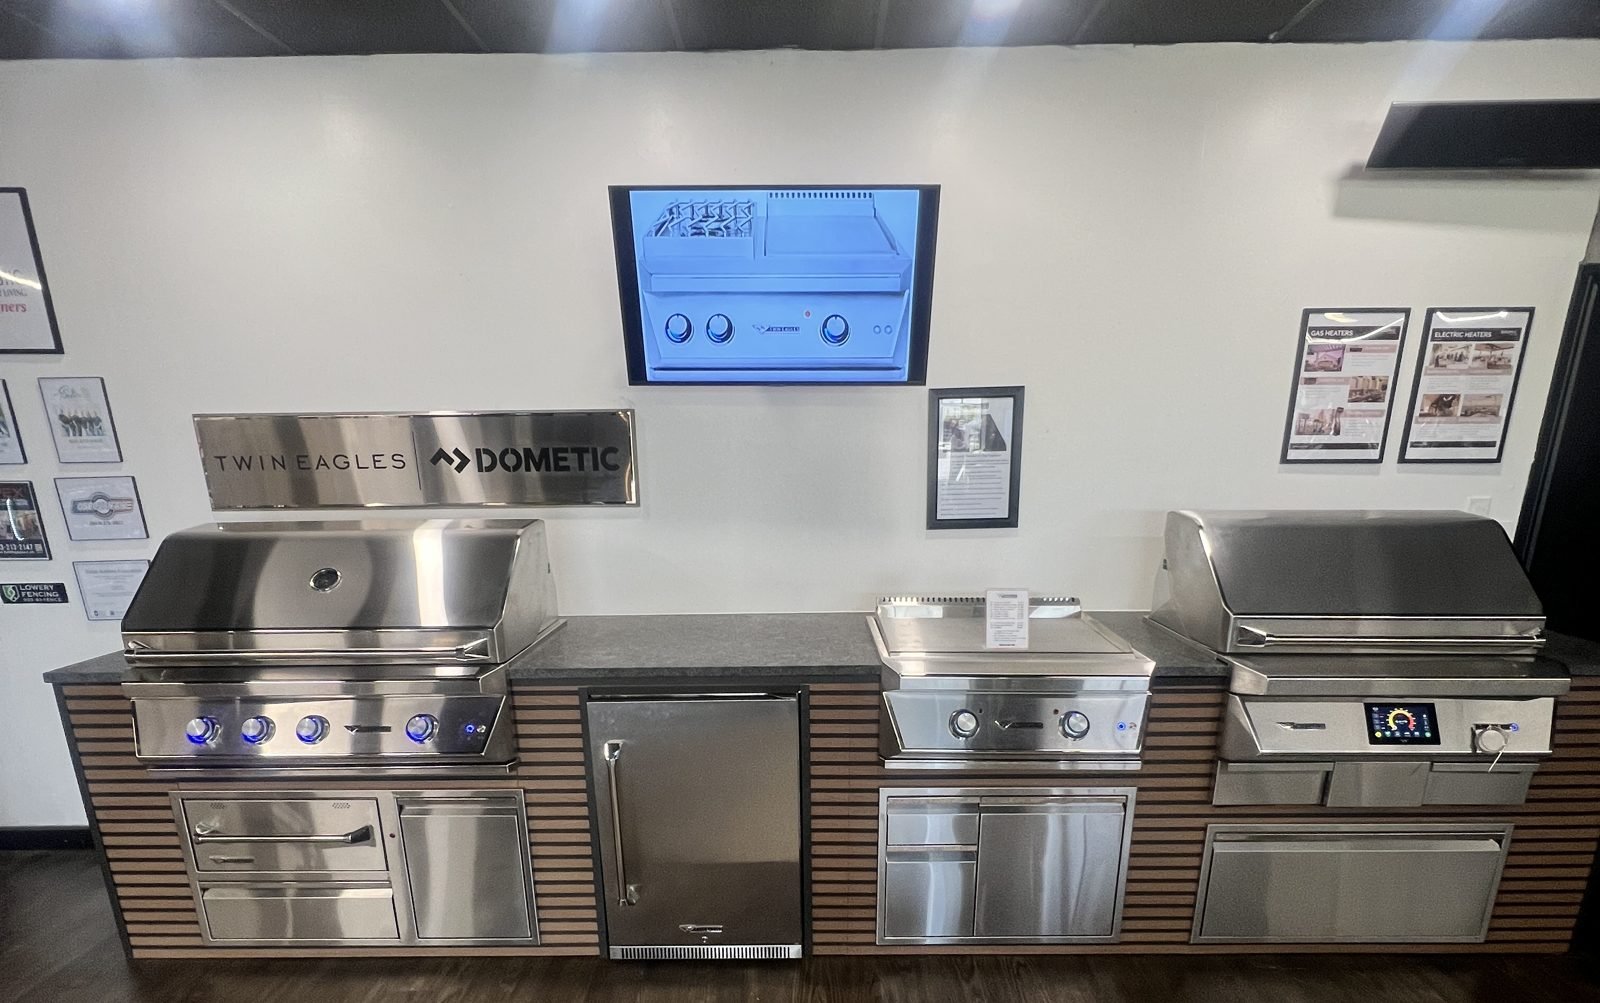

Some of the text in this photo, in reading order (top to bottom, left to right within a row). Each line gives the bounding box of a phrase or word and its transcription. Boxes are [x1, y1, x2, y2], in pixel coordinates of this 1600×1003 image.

[1310, 329, 1354, 337] GAS HEATERS
[213, 453, 407, 472] TWIN EAGLES
[475, 446, 621, 473] DOMETIC
